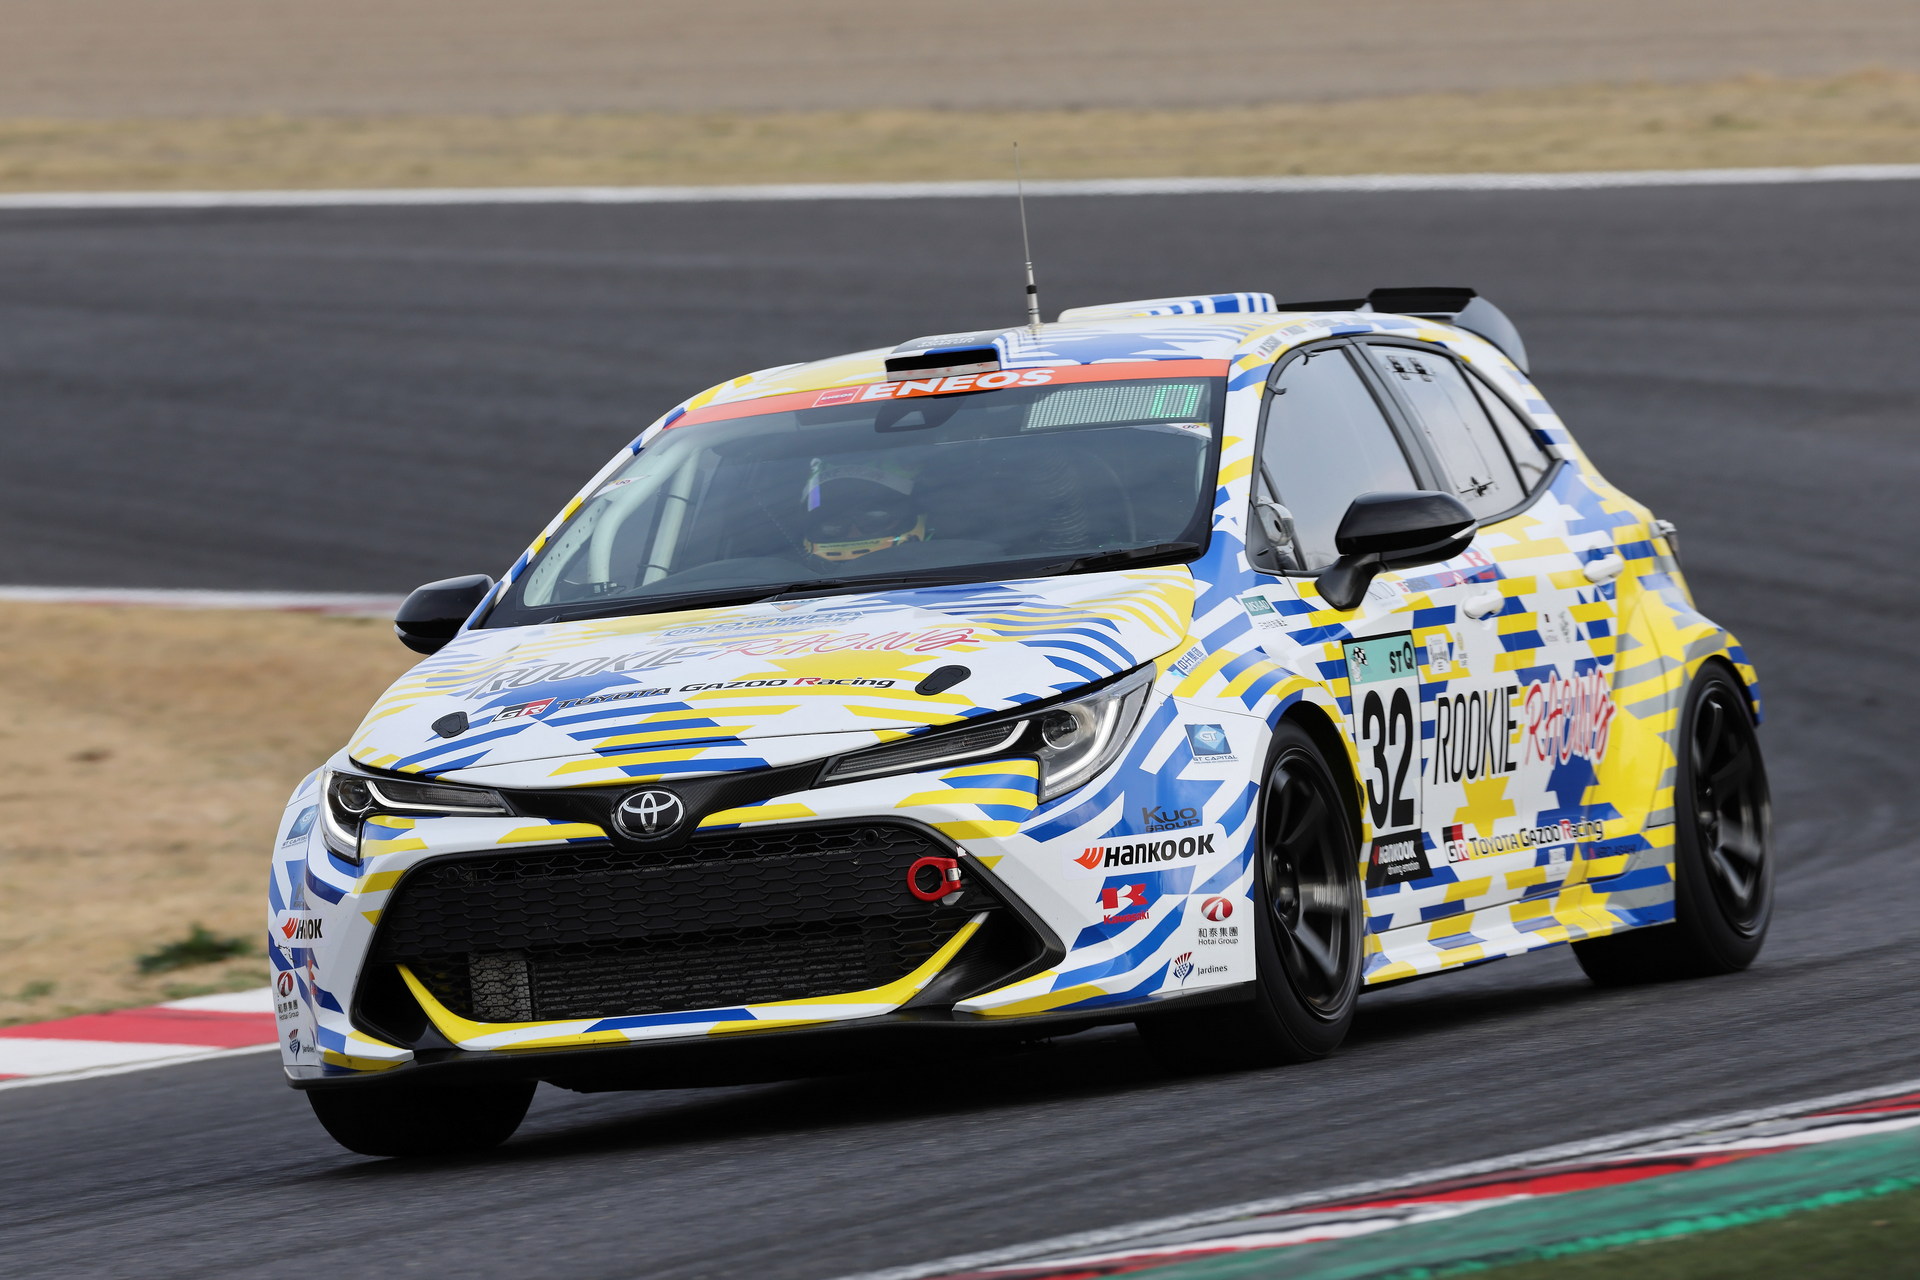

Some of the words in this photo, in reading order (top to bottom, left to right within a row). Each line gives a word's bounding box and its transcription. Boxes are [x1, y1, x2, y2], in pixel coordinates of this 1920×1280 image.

[861, 370, 1055, 400] ENEOS
[465, 644, 722, 700] ROOKIE
[708, 627, 981, 661] RACING
[556, 687, 671, 708] TOYOTA
[681, 678, 788, 692] GAZOO
[792, 676, 896, 690] Racing
[1434, 685, 1518, 785] ROOKIE
[1524, 668, 1616, 766] RACING
[1362, 687, 1414, 830] 32
[1469, 833, 1519, 856] TOYOTA
[1520, 824, 1560, 847] GAZOO
[1560, 817, 1603, 841] Racing
[1103, 909, 1149, 925] Kawasaki
[1198, 926, 1239, 938] 和泰集團
[1218, 937, 1239, 945] Group
[1197, 965, 1228, 976] Jardines
